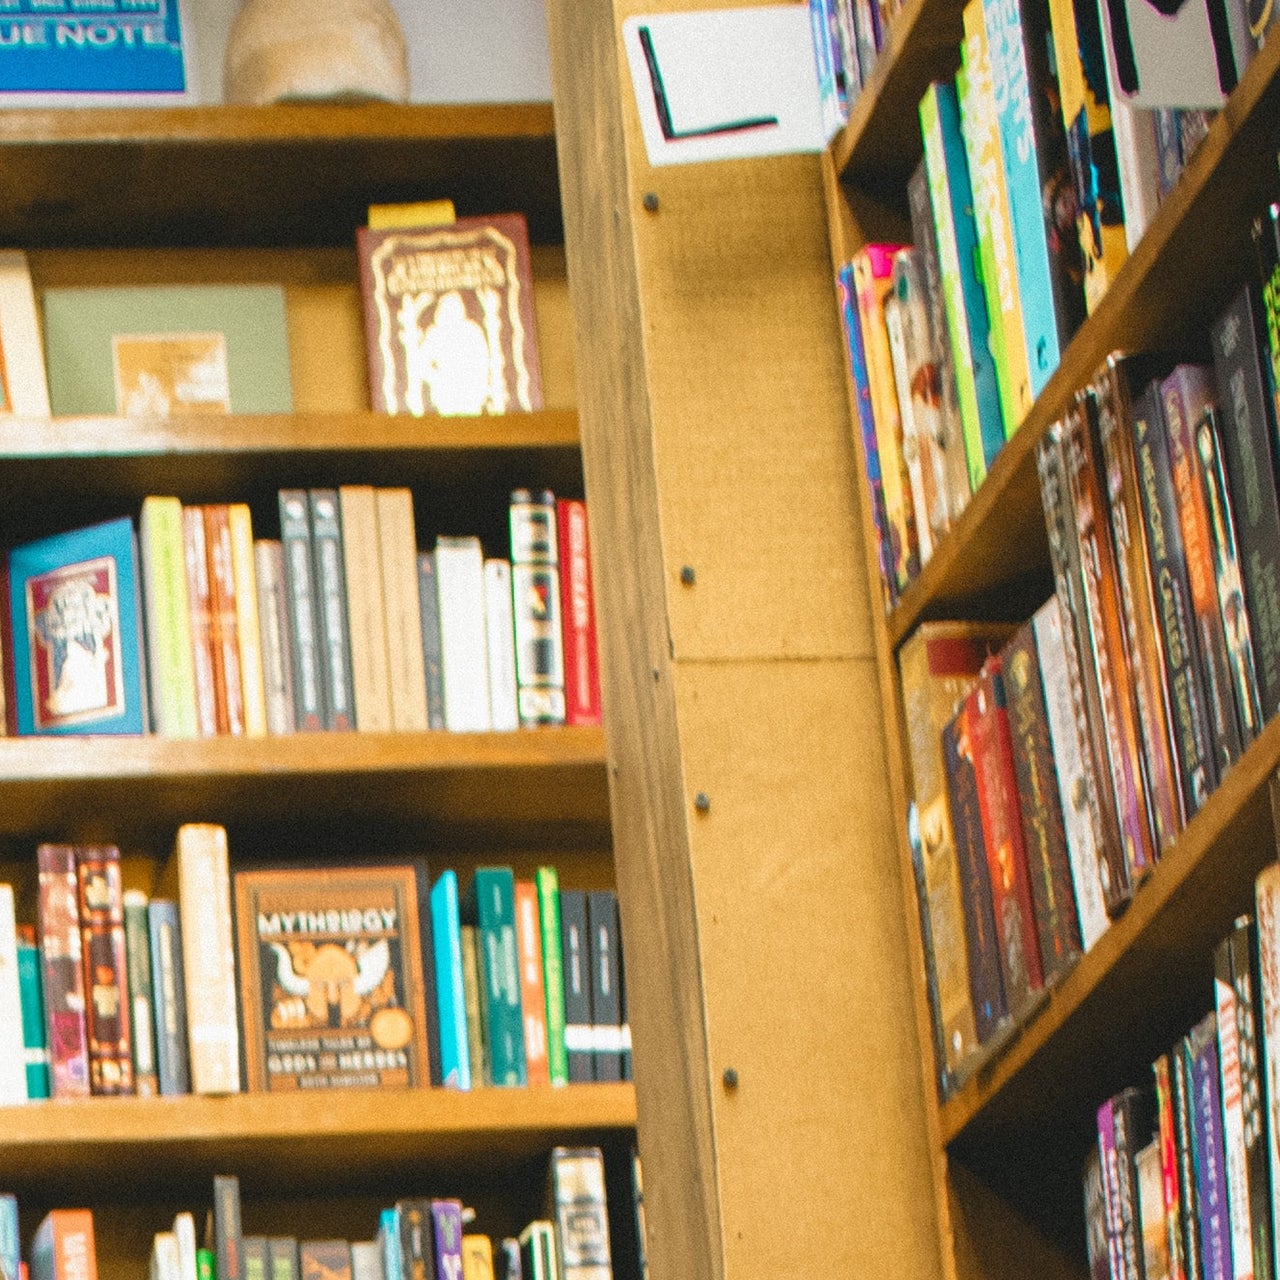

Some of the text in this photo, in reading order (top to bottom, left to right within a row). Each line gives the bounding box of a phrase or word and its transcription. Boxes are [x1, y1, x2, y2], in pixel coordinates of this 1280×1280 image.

[54, 21, 166, 47] NOTE
[1104, 0, 1240, 99] M
[638, 25, 780, 143] L
[257, 908, 397, 935] MYTHOLOGY
